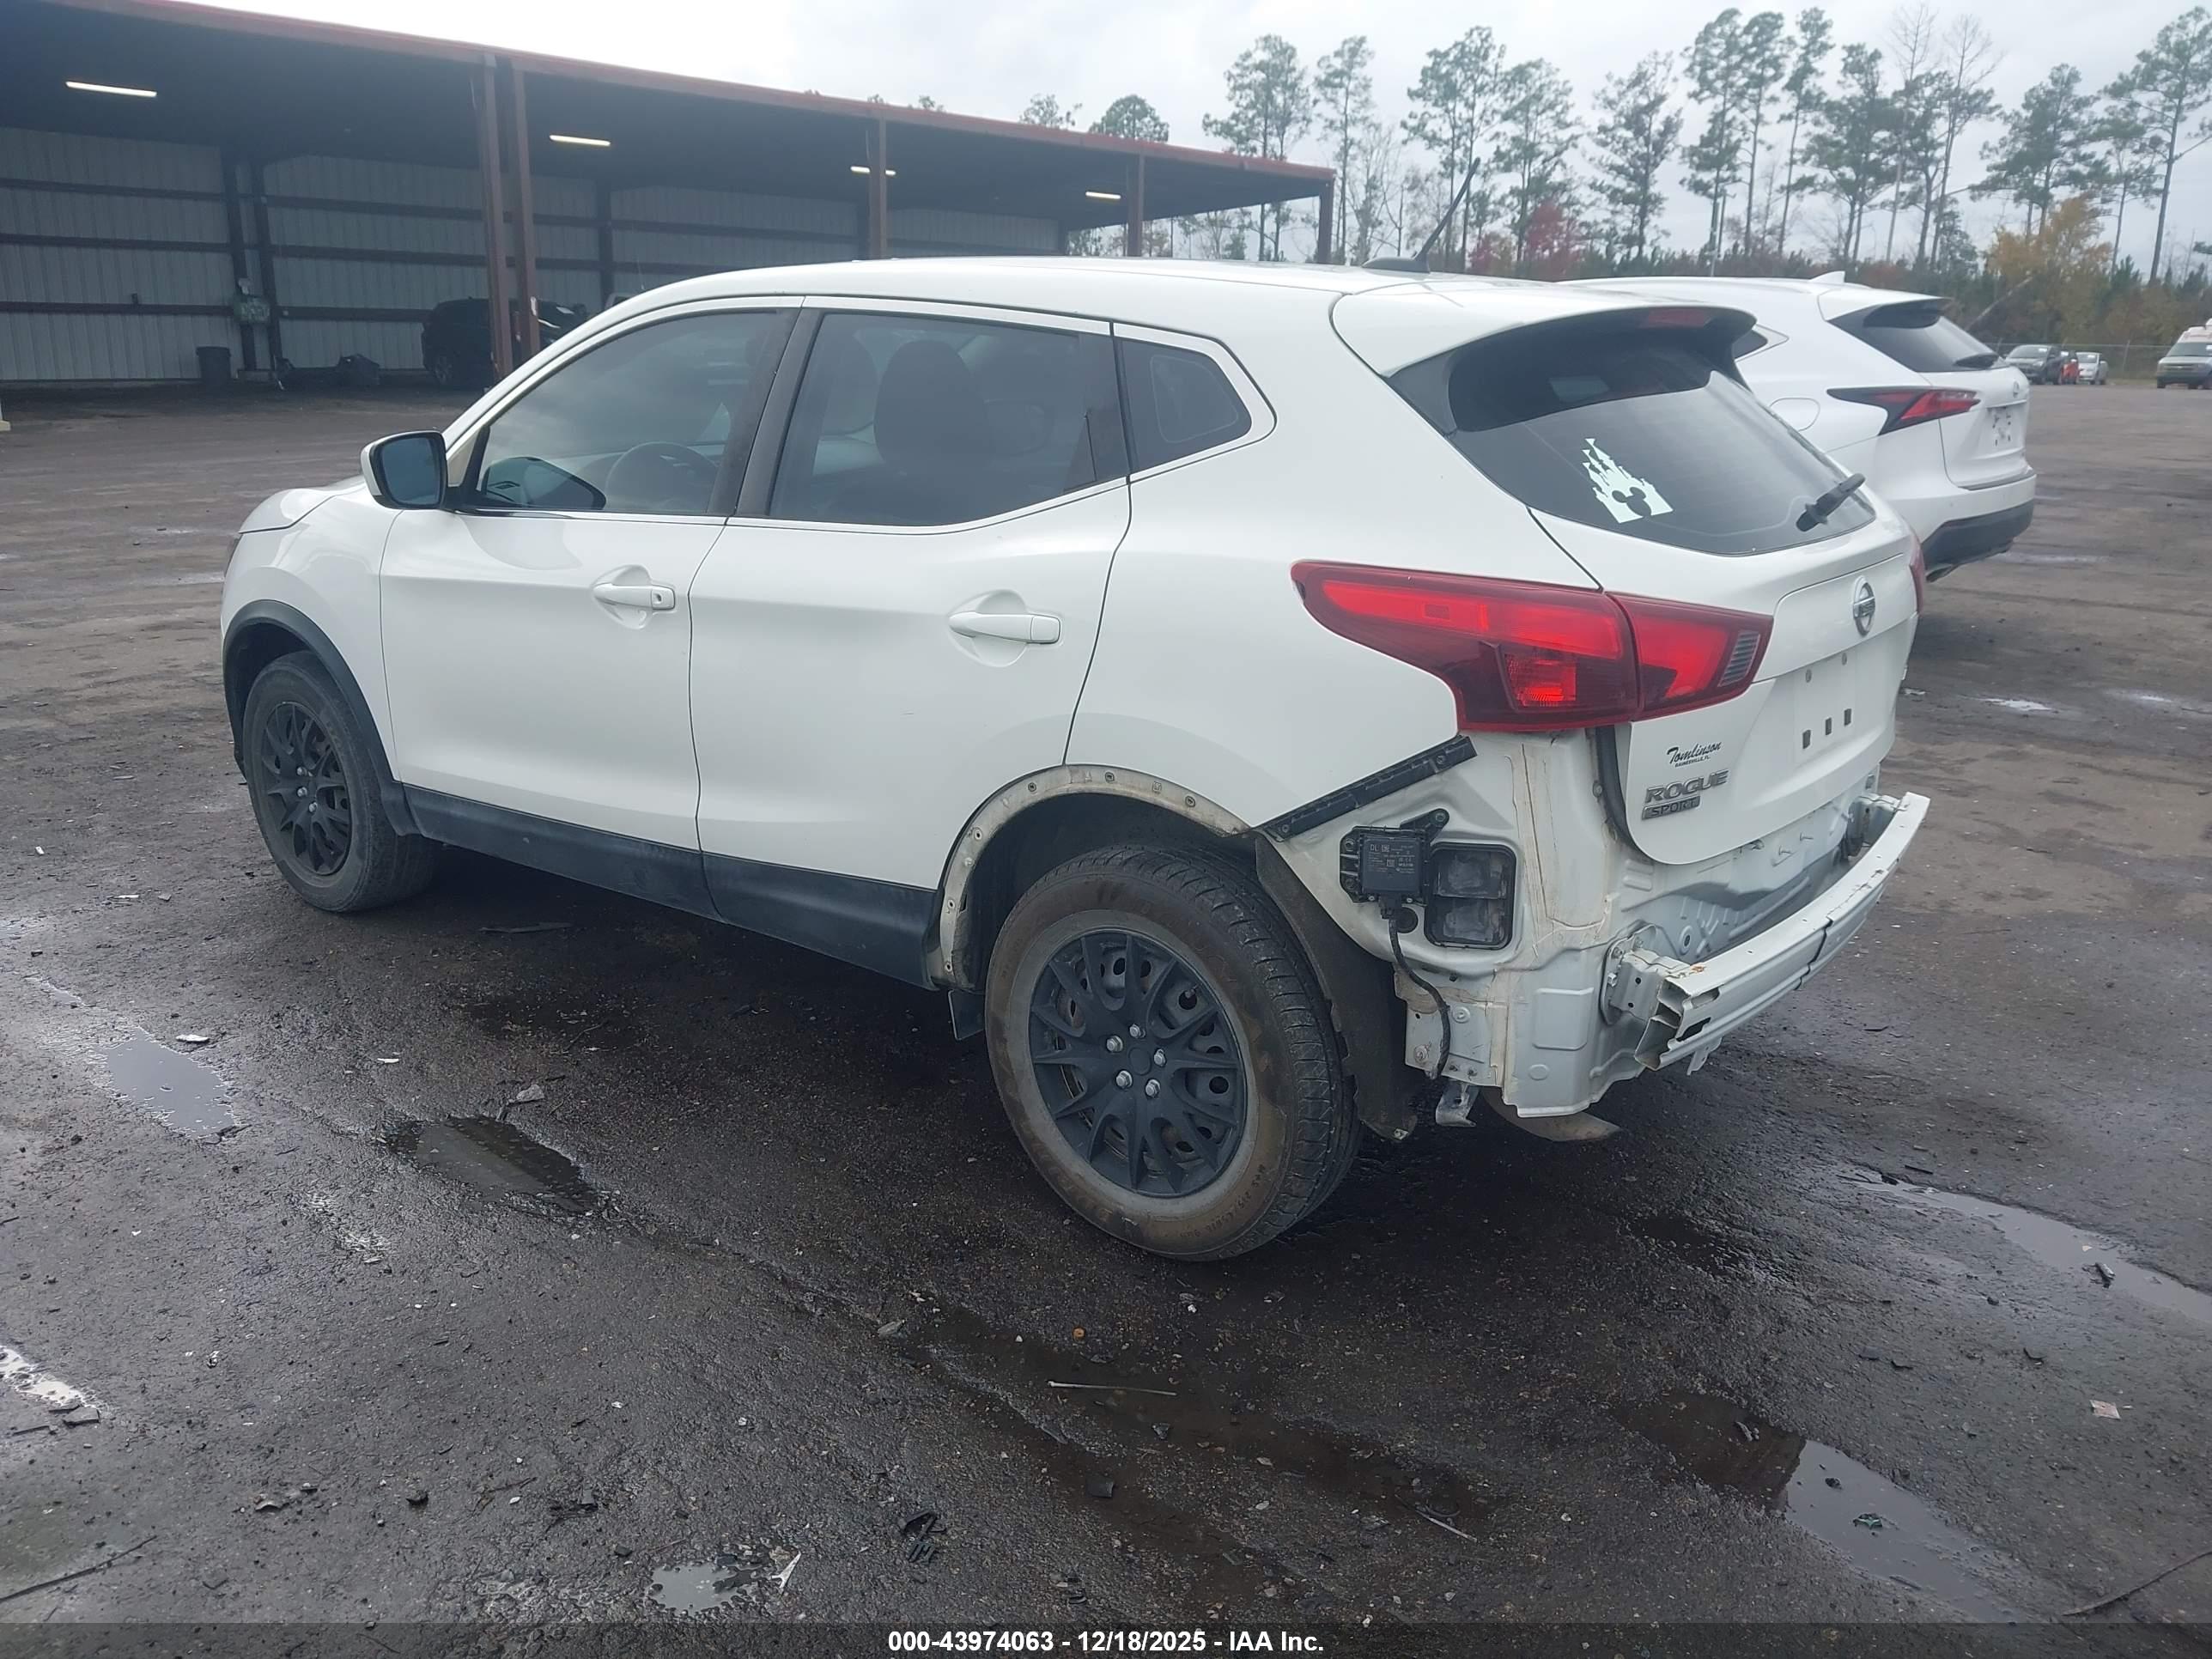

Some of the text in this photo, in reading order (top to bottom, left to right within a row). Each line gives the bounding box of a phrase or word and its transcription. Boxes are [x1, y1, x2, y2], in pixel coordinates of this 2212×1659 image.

[1667, 741, 1723, 764] Tomlinson
[1645, 769, 1729, 804] ROGUE
[1650, 797, 1699, 817] SPORT
